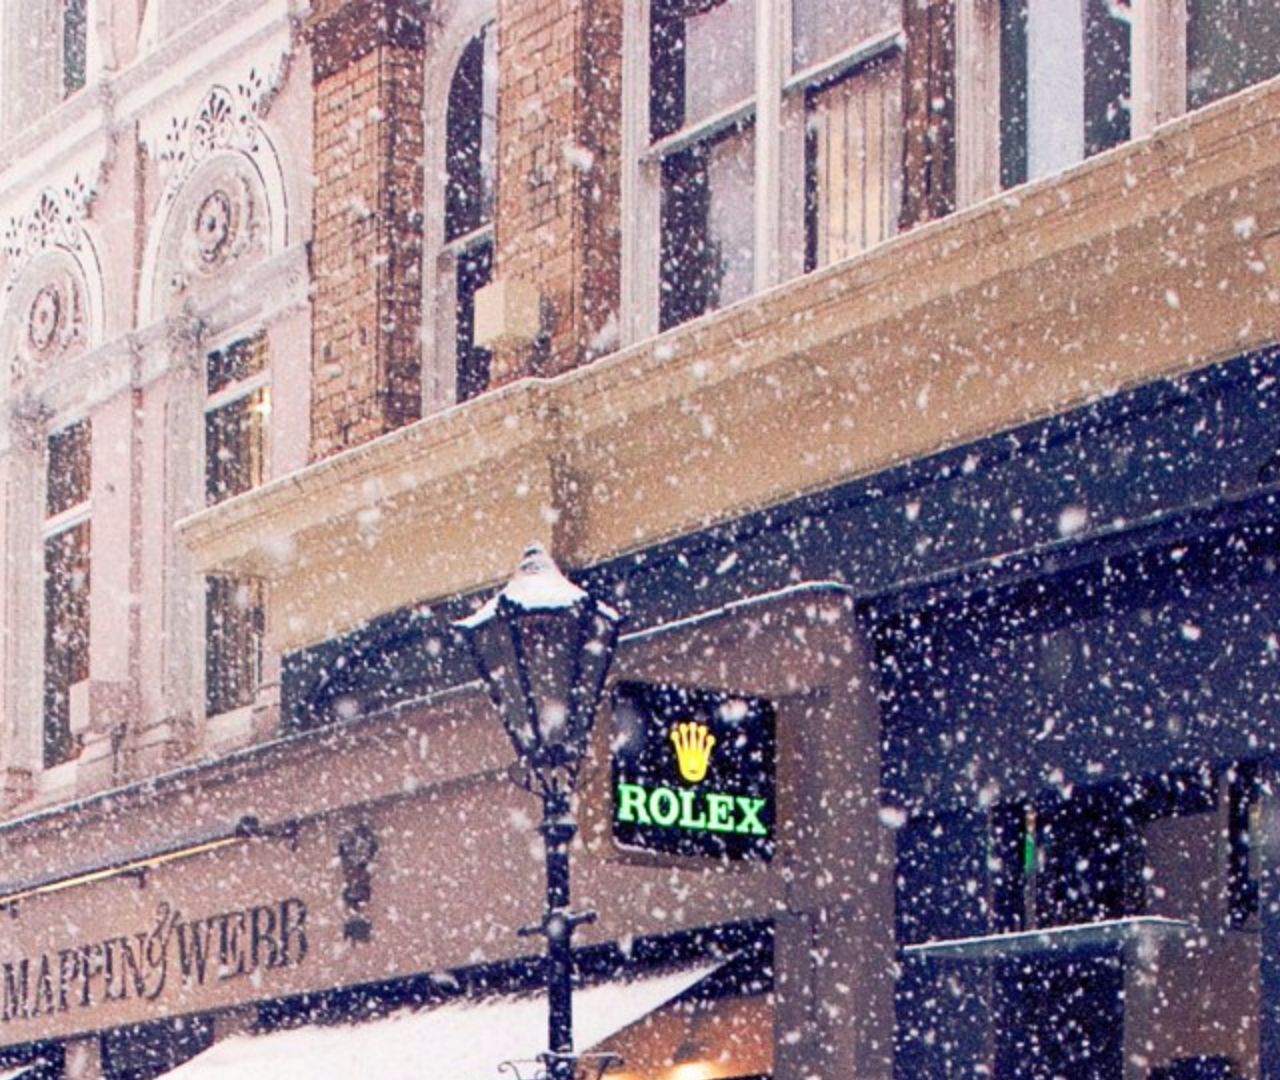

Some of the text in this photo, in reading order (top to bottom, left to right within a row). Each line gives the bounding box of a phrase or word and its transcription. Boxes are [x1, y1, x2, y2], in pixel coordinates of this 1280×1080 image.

[617, 782, 768, 835] ROLEX
[1, 932, 148, 1022] MAPPIN
[173, 897, 308, 985] WEBB
